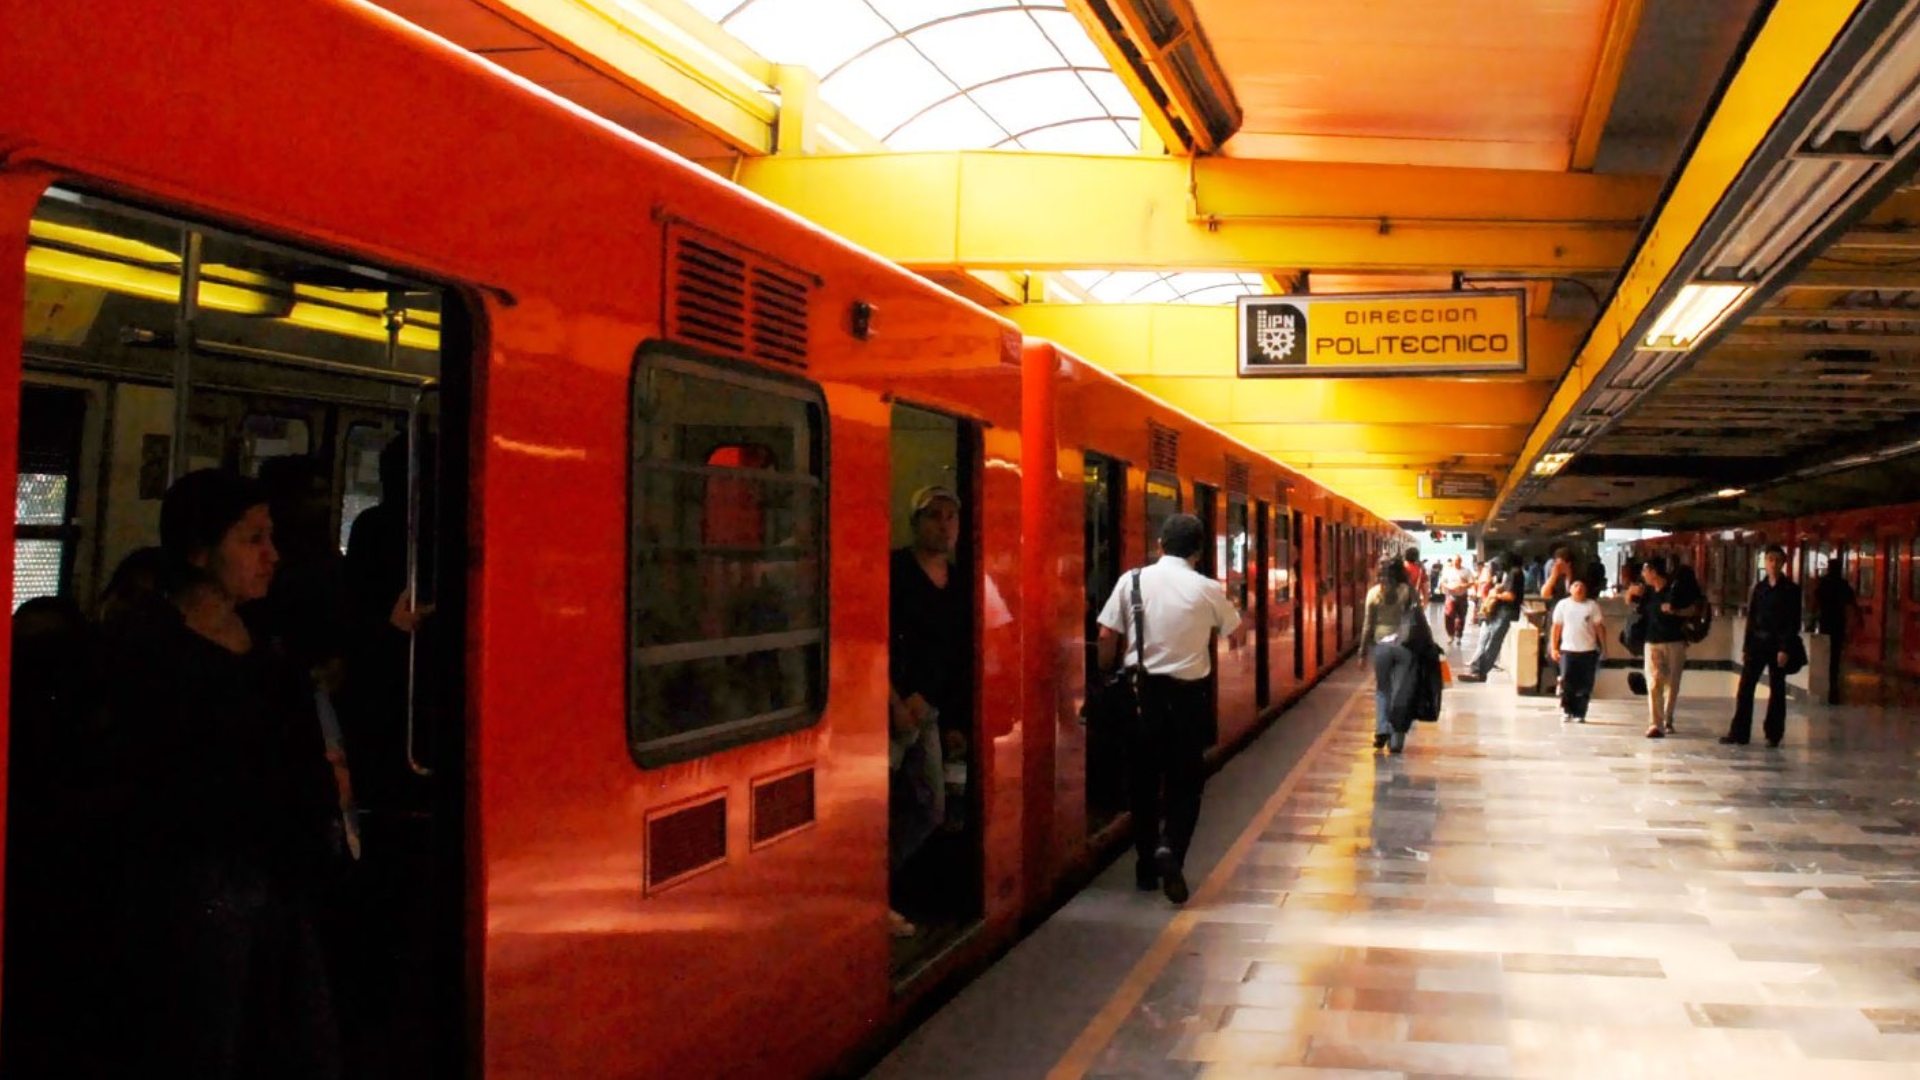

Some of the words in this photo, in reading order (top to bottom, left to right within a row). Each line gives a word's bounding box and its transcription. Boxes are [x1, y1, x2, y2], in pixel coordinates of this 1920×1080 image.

[1266, 314, 1295, 328] IPN
[1345, 308, 1477, 324] DIRECCION
[1315, 334, 1508, 355] POLITECNICO
